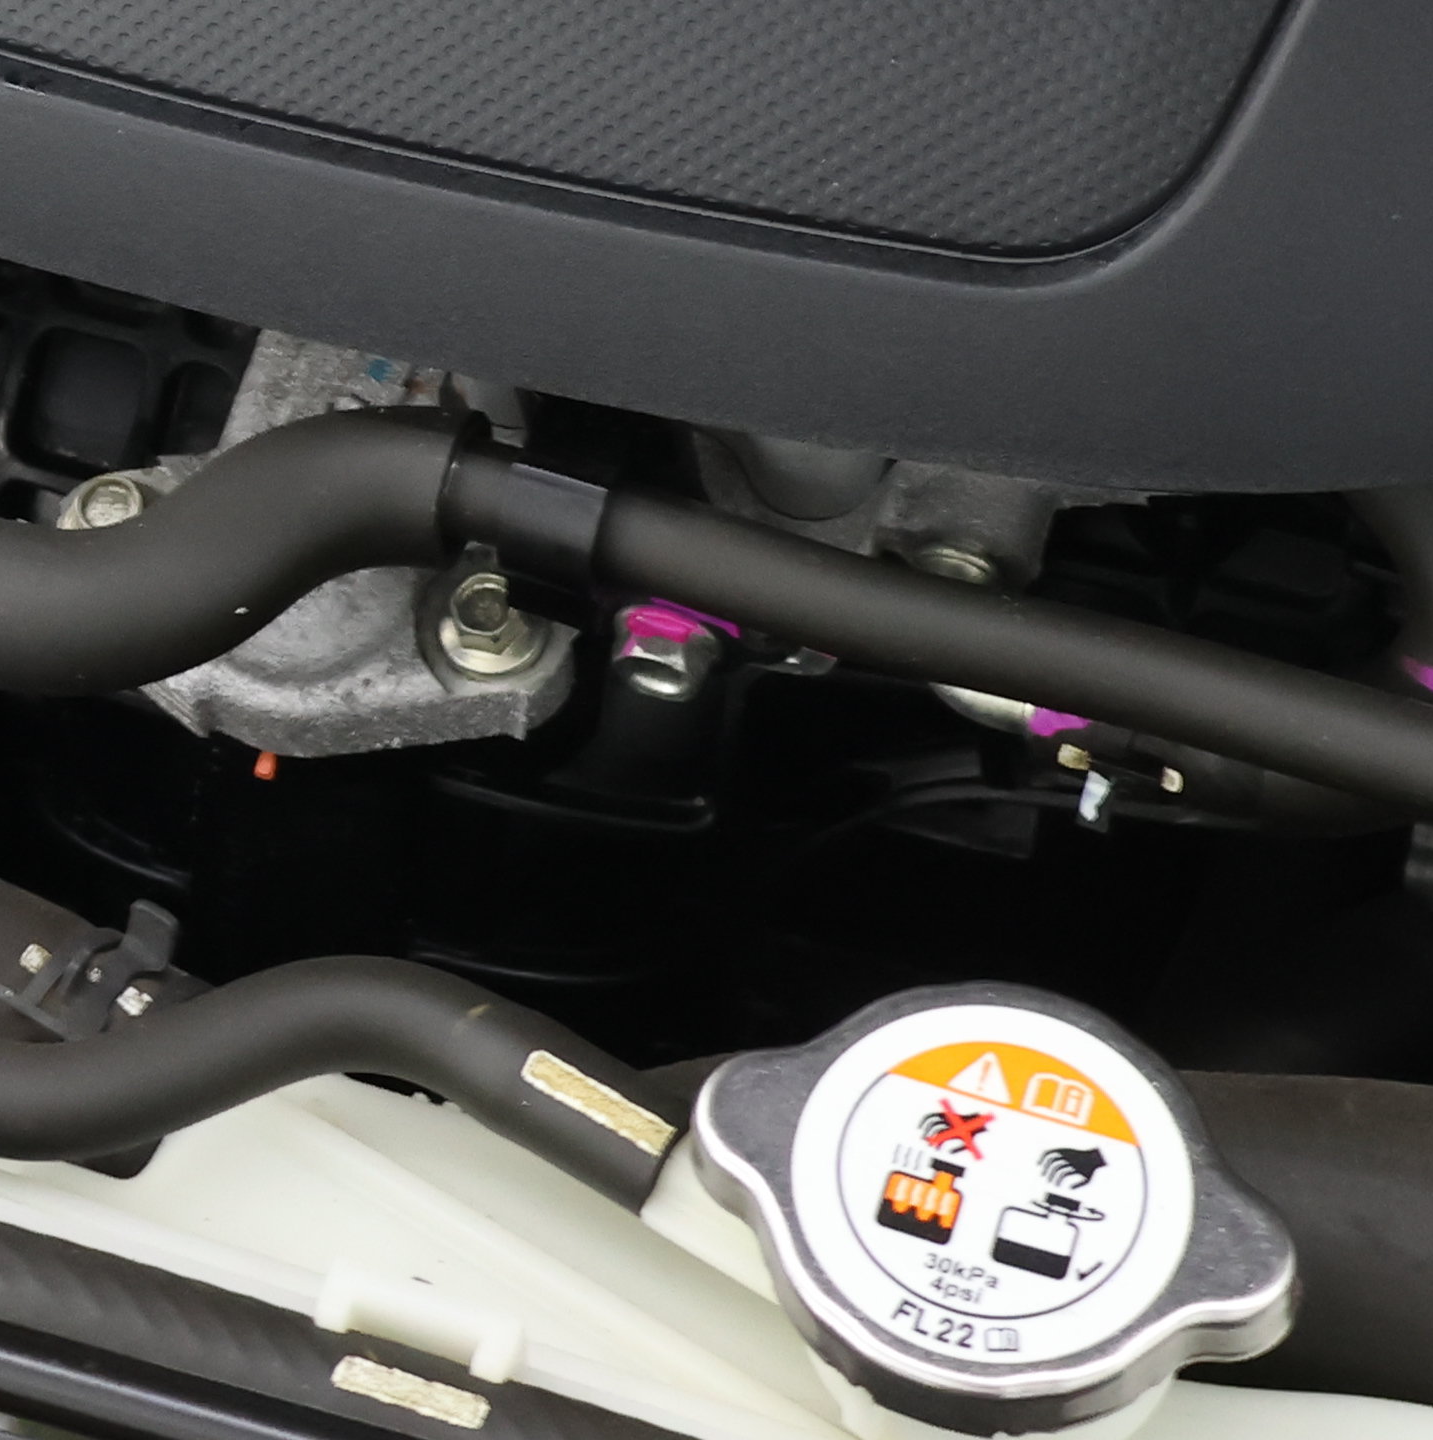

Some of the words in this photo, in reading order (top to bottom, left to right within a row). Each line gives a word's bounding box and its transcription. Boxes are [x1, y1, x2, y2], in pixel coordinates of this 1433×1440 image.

[924, 1252, 999, 1289] 30kPa
[930, 1276, 983, 1304] 4psi
[891, 1299, 975, 1349] FL22
